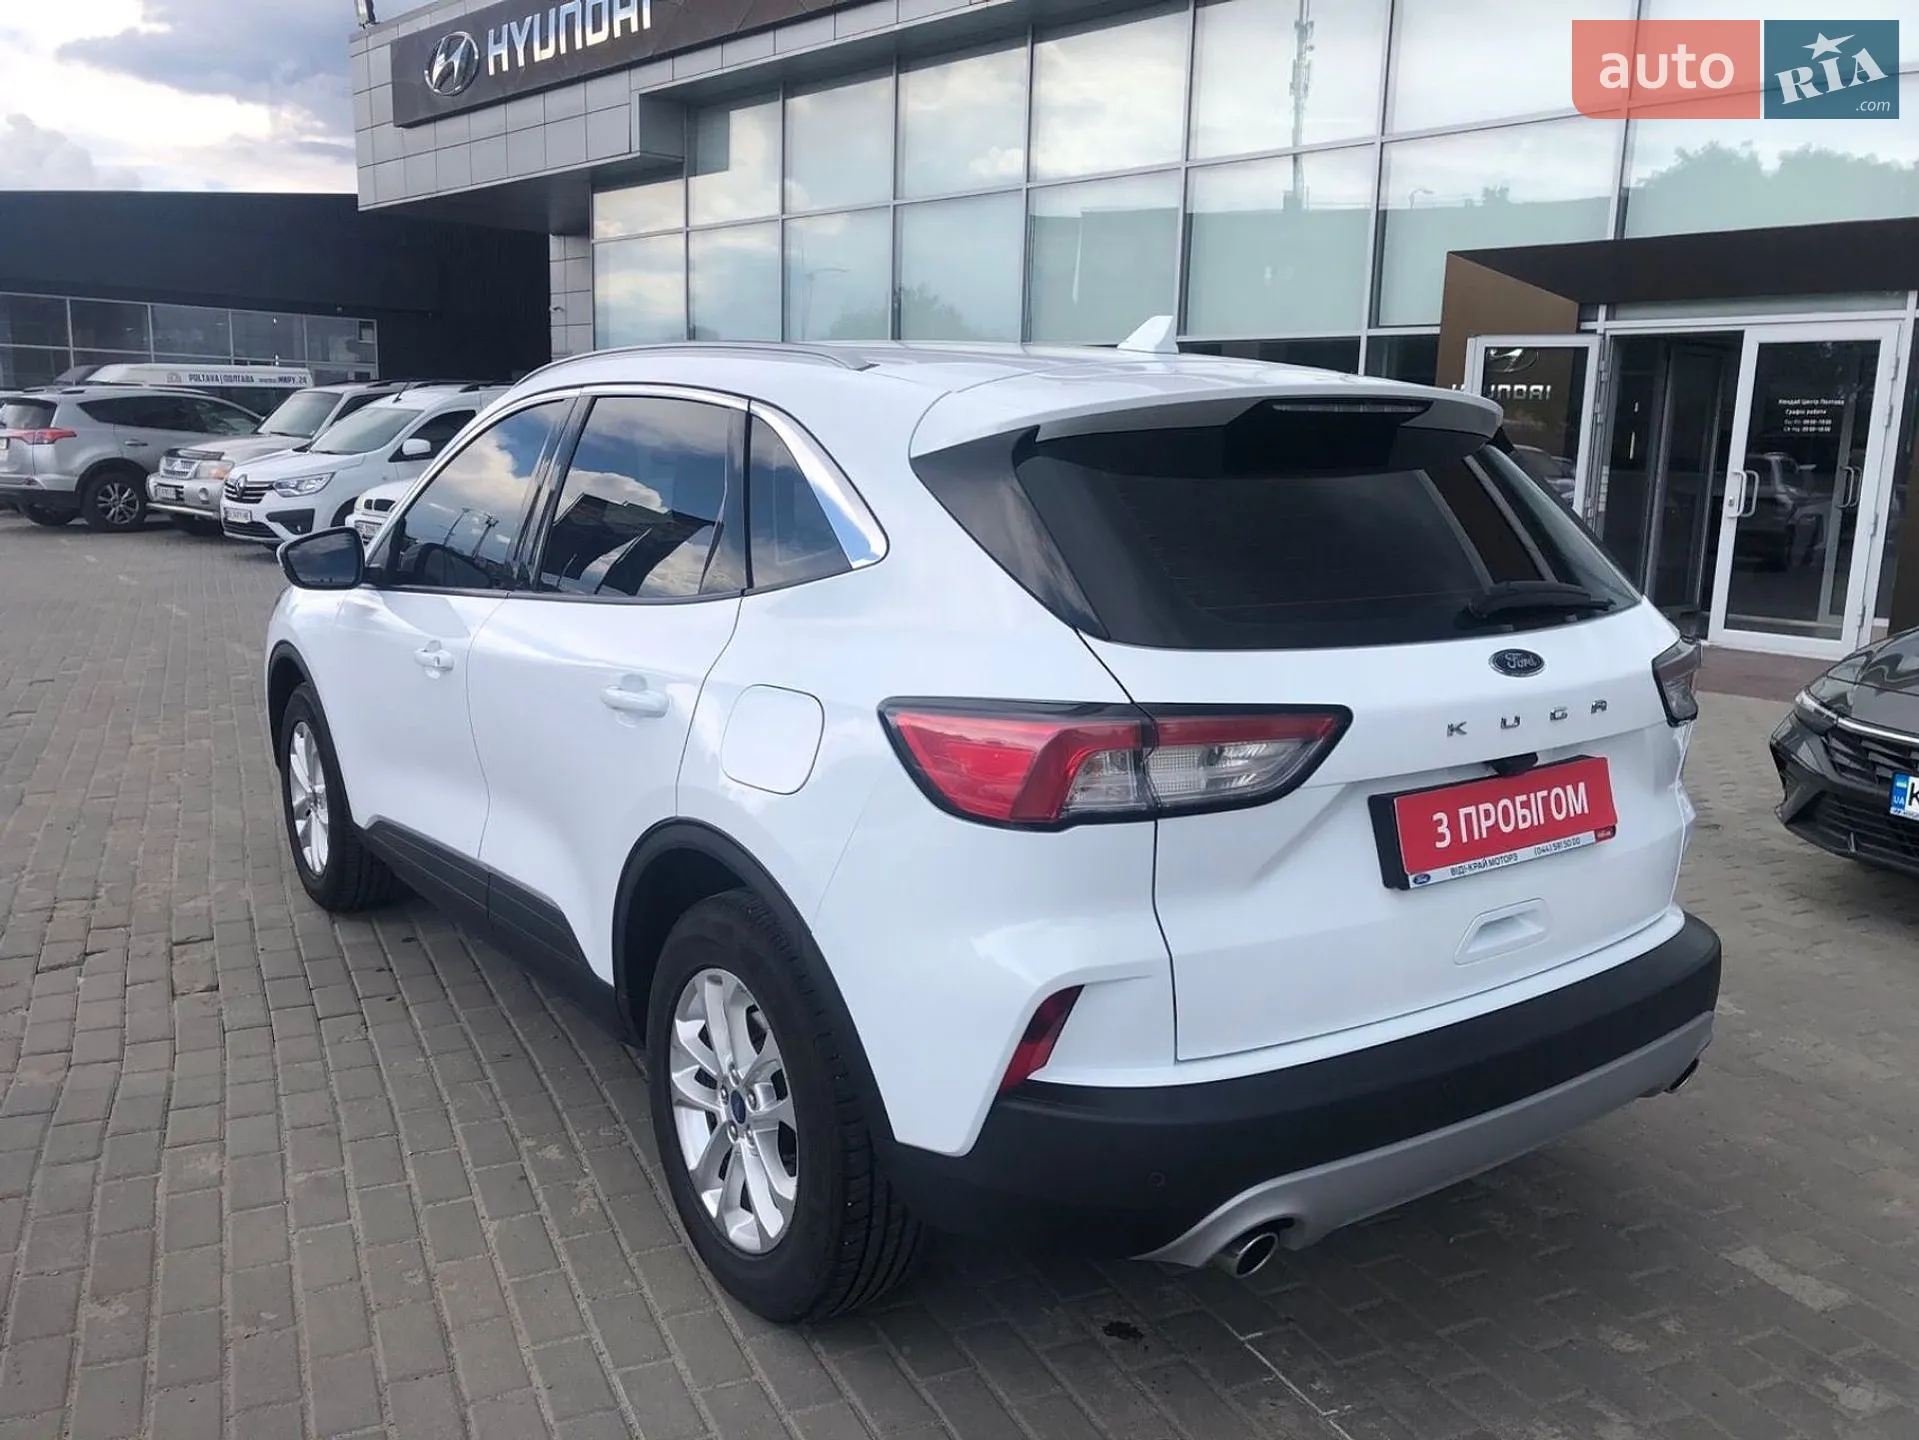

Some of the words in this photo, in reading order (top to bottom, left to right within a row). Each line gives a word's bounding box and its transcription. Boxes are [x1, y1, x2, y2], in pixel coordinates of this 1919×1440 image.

[487, 0, 651, 76] HYUNDAI
[1451, 383, 1552, 400] NDAI
[1447, 699, 1608, 737] KUGA
[1459, 781, 1589, 843] ПРОБІГОМ
